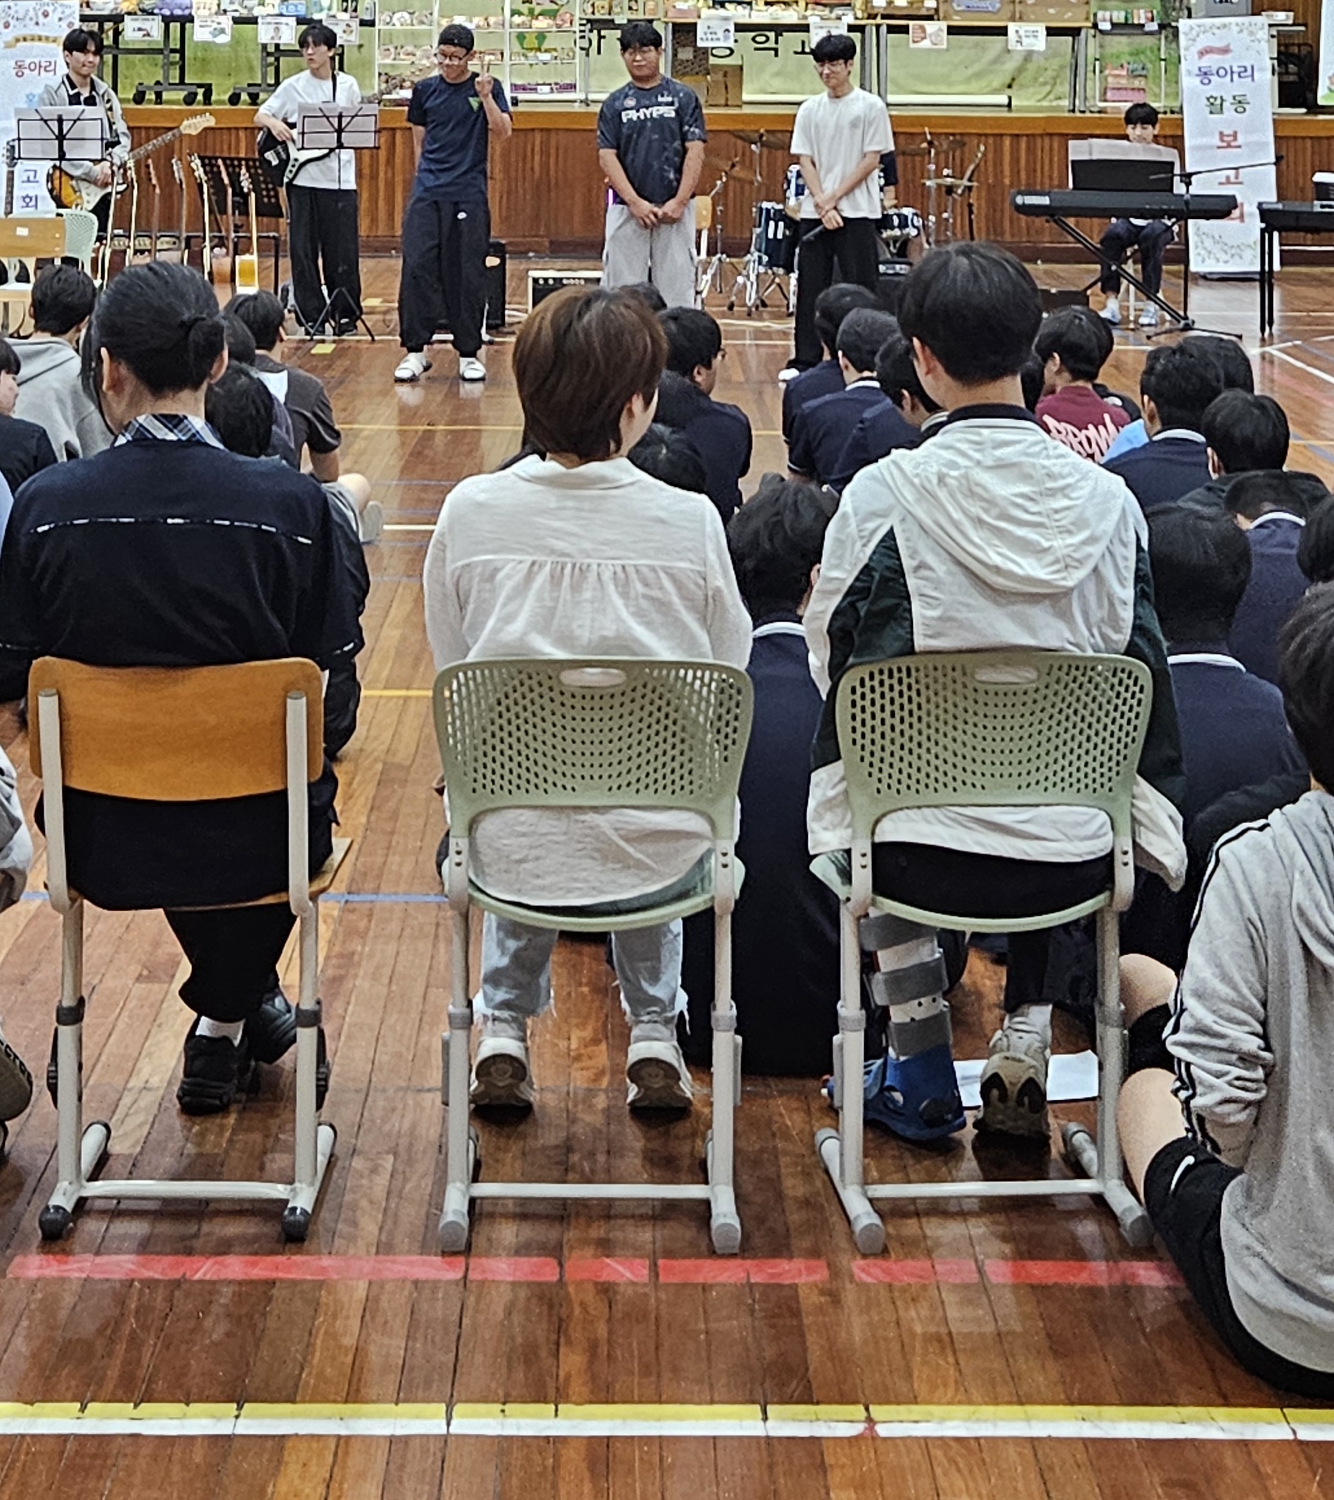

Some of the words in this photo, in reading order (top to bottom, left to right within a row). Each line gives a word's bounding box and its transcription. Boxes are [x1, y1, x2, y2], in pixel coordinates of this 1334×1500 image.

[12, 59, 58, 78] 동아리
[1195, 64, 1256, 86] 동아리
[1205, 94, 1251, 115] 활동
